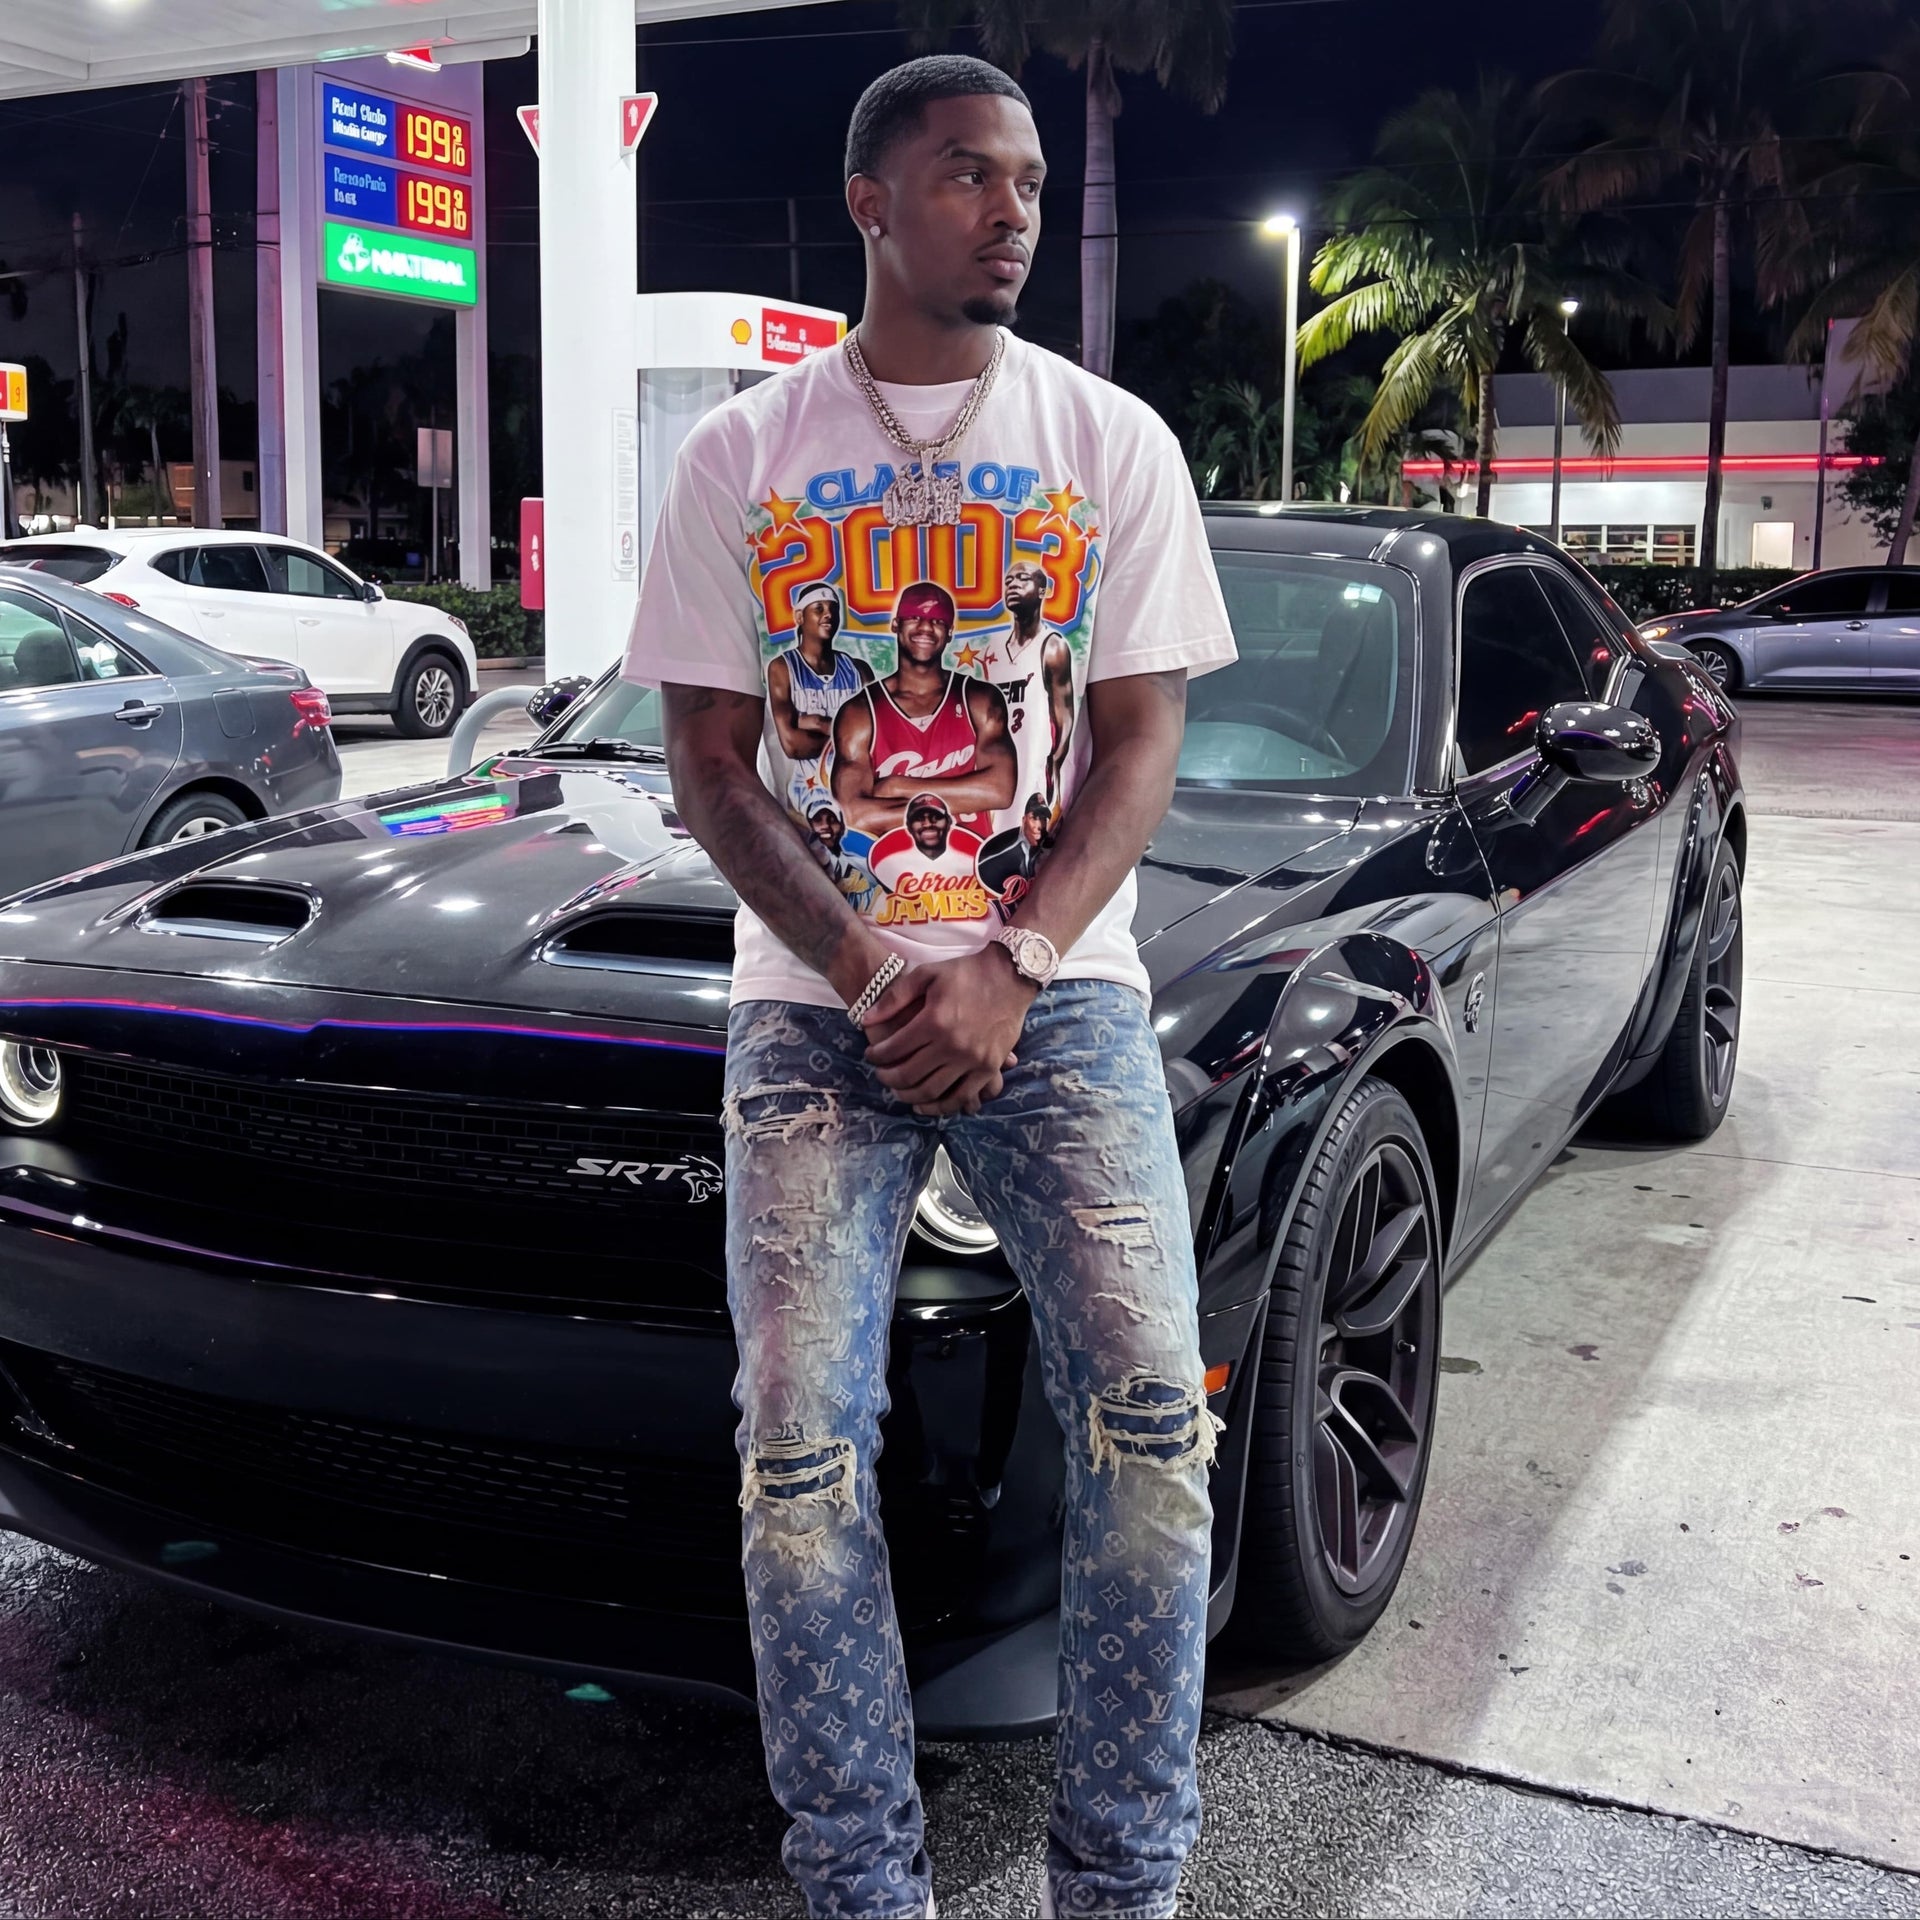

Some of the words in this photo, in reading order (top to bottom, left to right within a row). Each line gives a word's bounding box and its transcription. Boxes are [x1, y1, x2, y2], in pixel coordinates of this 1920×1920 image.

[805, 460, 962, 510] CLA
[967, 462, 1040, 504] OF
[756, 502, 1088, 644] 2003
[876, 889, 989, 926] JAMES
[566, 1157, 690, 1185] SRT
